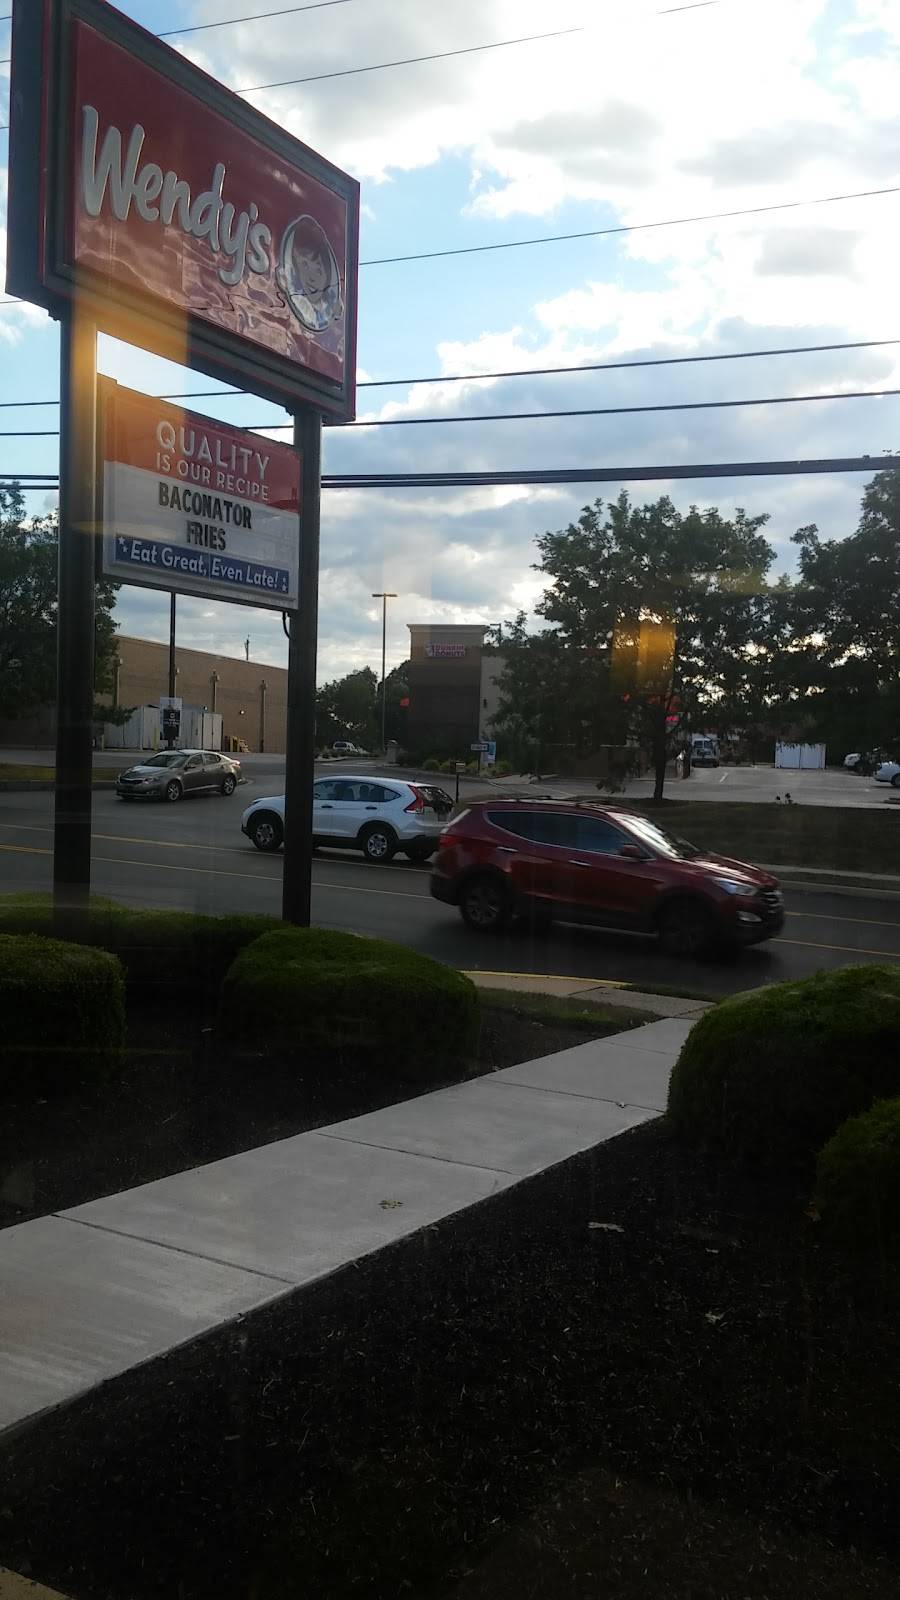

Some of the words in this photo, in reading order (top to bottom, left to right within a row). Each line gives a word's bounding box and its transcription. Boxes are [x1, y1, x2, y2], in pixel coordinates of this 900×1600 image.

[82, 104, 272, 286] Wendy's
[156, 421, 269, 480] QUALITY
[155, 452, 171, 473] IS
[177, 459, 210, 485] OUR
[216, 472, 269, 501] RECIPE
[158, 481, 252, 529] BACONATOR
[186, 520, 226, 550] FRIES
[130, 539, 157, 562] Eat
[161, 547, 208, 575] Great,
[211, 558, 242, 582] Even
[246, 564, 279, 589] Late!
